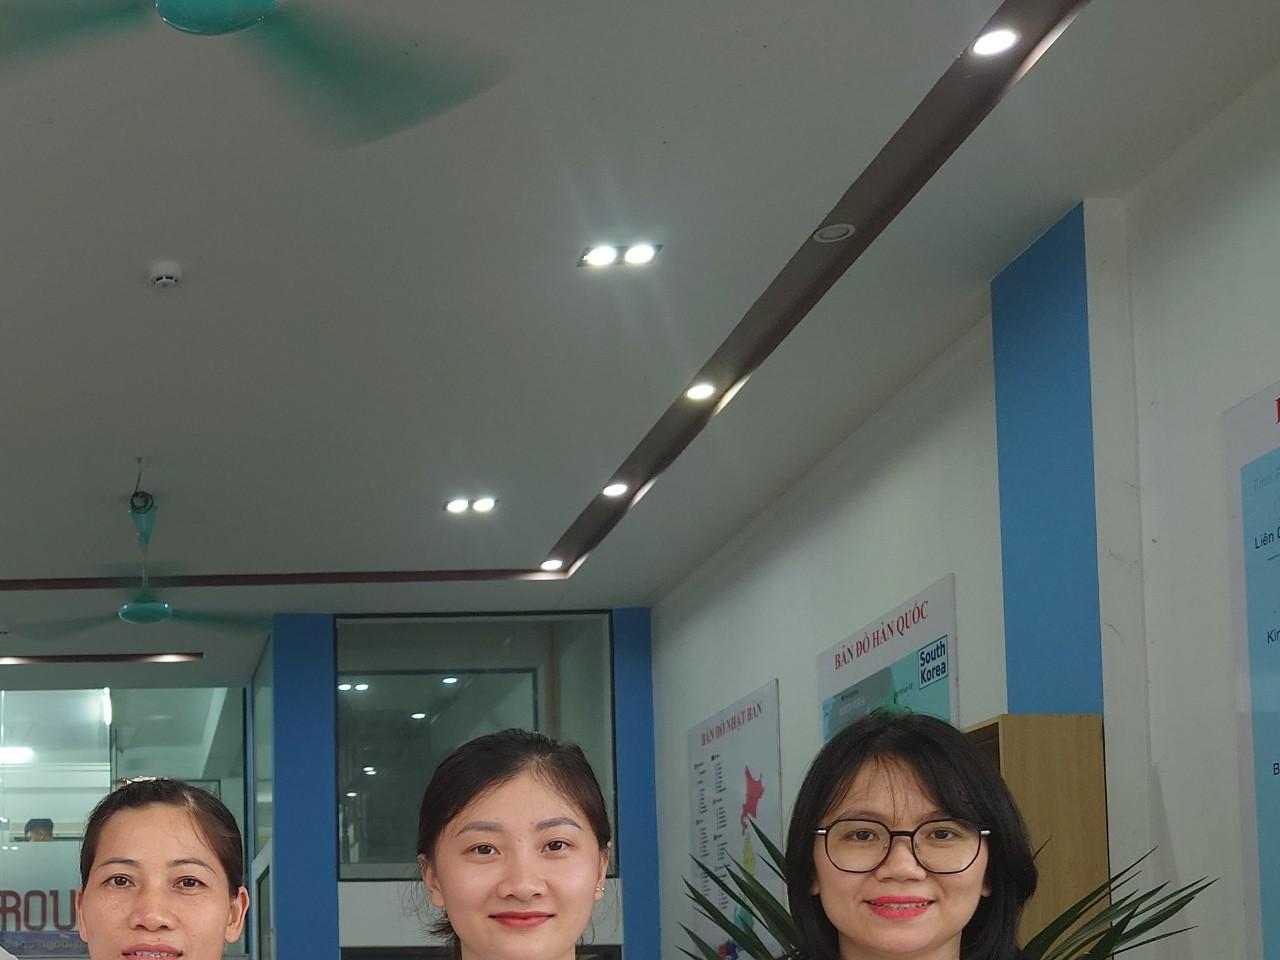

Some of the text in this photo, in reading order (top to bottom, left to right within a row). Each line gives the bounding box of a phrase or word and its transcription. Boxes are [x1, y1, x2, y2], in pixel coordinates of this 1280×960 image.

[1254, 532, 1274, 549] Liên
[872, 621, 896, 648] HÀN
[896, 600, 929, 636] QUỐC
[919, 640, 946, 667] South
[920, 661, 946, 685] Korea
